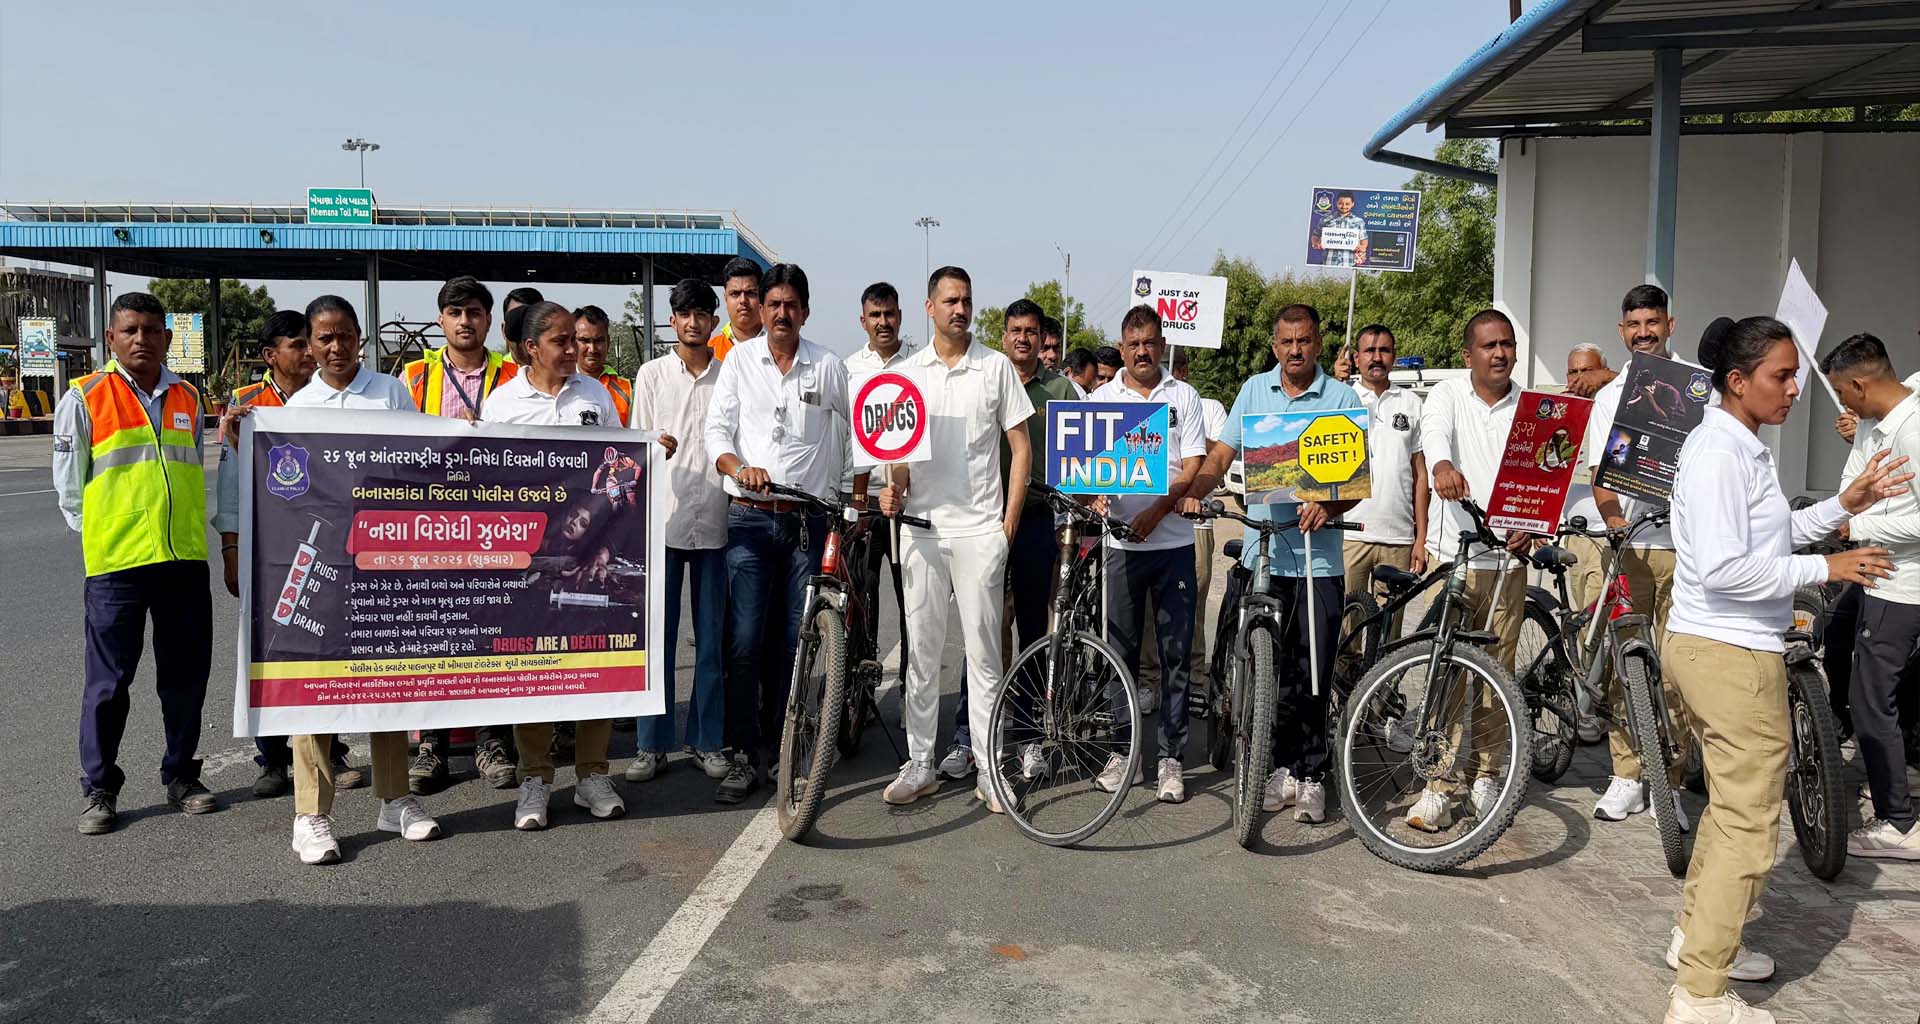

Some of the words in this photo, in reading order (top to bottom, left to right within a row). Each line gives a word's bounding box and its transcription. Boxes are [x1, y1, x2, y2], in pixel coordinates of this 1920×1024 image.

[310, 207, 338, 217] Khemana
[340, 207, 352, 217] Toll
[353, 207, 370, 217] Plaza
[1158, 289, 1181, 297] JUST
[1183, 290, 1200, 299] SAY
[1162, 320, 1196, 330] DRUGS
[864, 400, 916, 434] DRUGS
[1056, 411, 1124, 451] FIT
[1303, 431, 1359, 448] SAFETY
[323, 450, 341, 463] ૨૬
[345, 450, 366, 470] જૂન
[369, 446, 441, 468] આંતરરાષ્ટ્રીય
[503, 449, 544, 467] દિવસની
[547, 451, 588, 469] ઉજવણી
[1307, 451, 1349, 465] FIRST
[1060, 456, 1153, 487] INDIA
[352, 484, 424, 501] બનાસકાંઠા
[429, 484, 468, 501] જિલ્લા
[472, 484, 514, 502] પોલીસ
[518, 485, 551, 502] ઉજવે
[554, 486, 568, 502] છે
[414, 514, 471, 541] વિરોધી
[390, 555, 405, 565] ૨૬
[409, 555, 429, 569] જૂન
[432, 555, 463, 566] ૨૦૨૬
[313, 561, 339, 581] RUGS
[306, 578, 321, 593] RD
[369, 579, 379, 591] એ
[380, 579, 392, 591] ઝેર
[406, 578, 430, 590] તેનાથી
[449, 578, 465, 590] અને
[298, 595, 310, 610] AL
[351, 594, 375, 609] યુવાનો
[377, 594, 391, 606] માટે
[411, 594, 420, 606] એ
[422, 597, 436, 606] માત્ર
[486, 596, 502, 604] જાય
[351, 611, 379, 623] એકવાર
[380, 613, 394, 622] પણ
[416, 609, 438, 622] કાયમી
[293, 612, 326, 637] DRAMS
[351, 629, 372, 638] તમારા
[374, 625, 400, 638] બાળકો
[401, 625, 417, 637] અને
[419, 625, 444, 637] પરિવાર
[446, 627, 457, 636] પર
[458, 623, 478, 635] આનો
[480, 626, 502, 635] ખરાબ
[375, 645, 383, 654] ન
[493, 636, 534, 653] DRUGS
[535, 635, 558, 652] ARE
[560, 635, 569, 651] A
[570, 634, 606, 650] DEATH
[608, 633, 637, 649] TRAP
